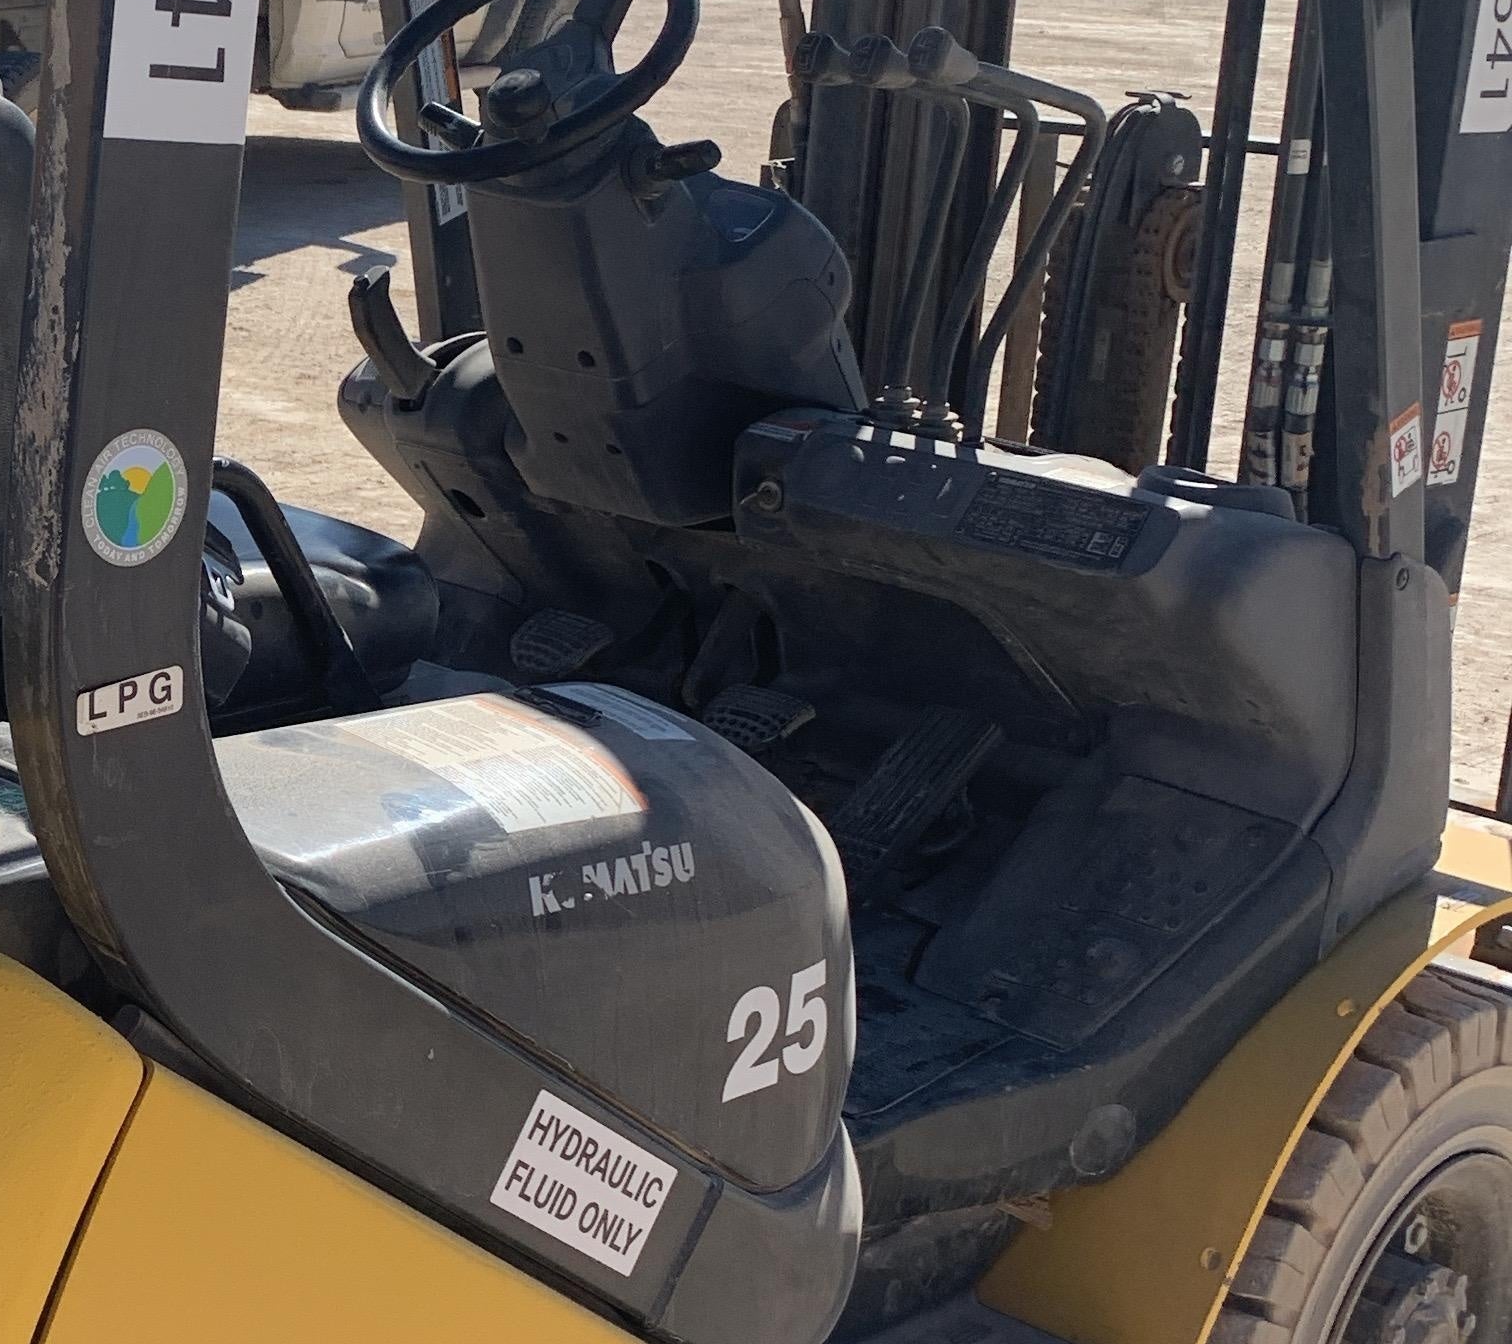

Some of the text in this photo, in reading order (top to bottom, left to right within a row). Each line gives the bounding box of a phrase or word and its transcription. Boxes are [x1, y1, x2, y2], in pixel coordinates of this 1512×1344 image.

[83, 433, 187, 528] CLEAN AIR TECHNOLOGY
[92, 486, 187, 562] TODAY AND TOMORROW
[528, 840, 695, 917] KMATSU
[721, 958, 828, 1104] 25
[527, 1108, 664, 1209] HYDRAULIC
[504, 1159, 643, 1256] FLUID ONLY
